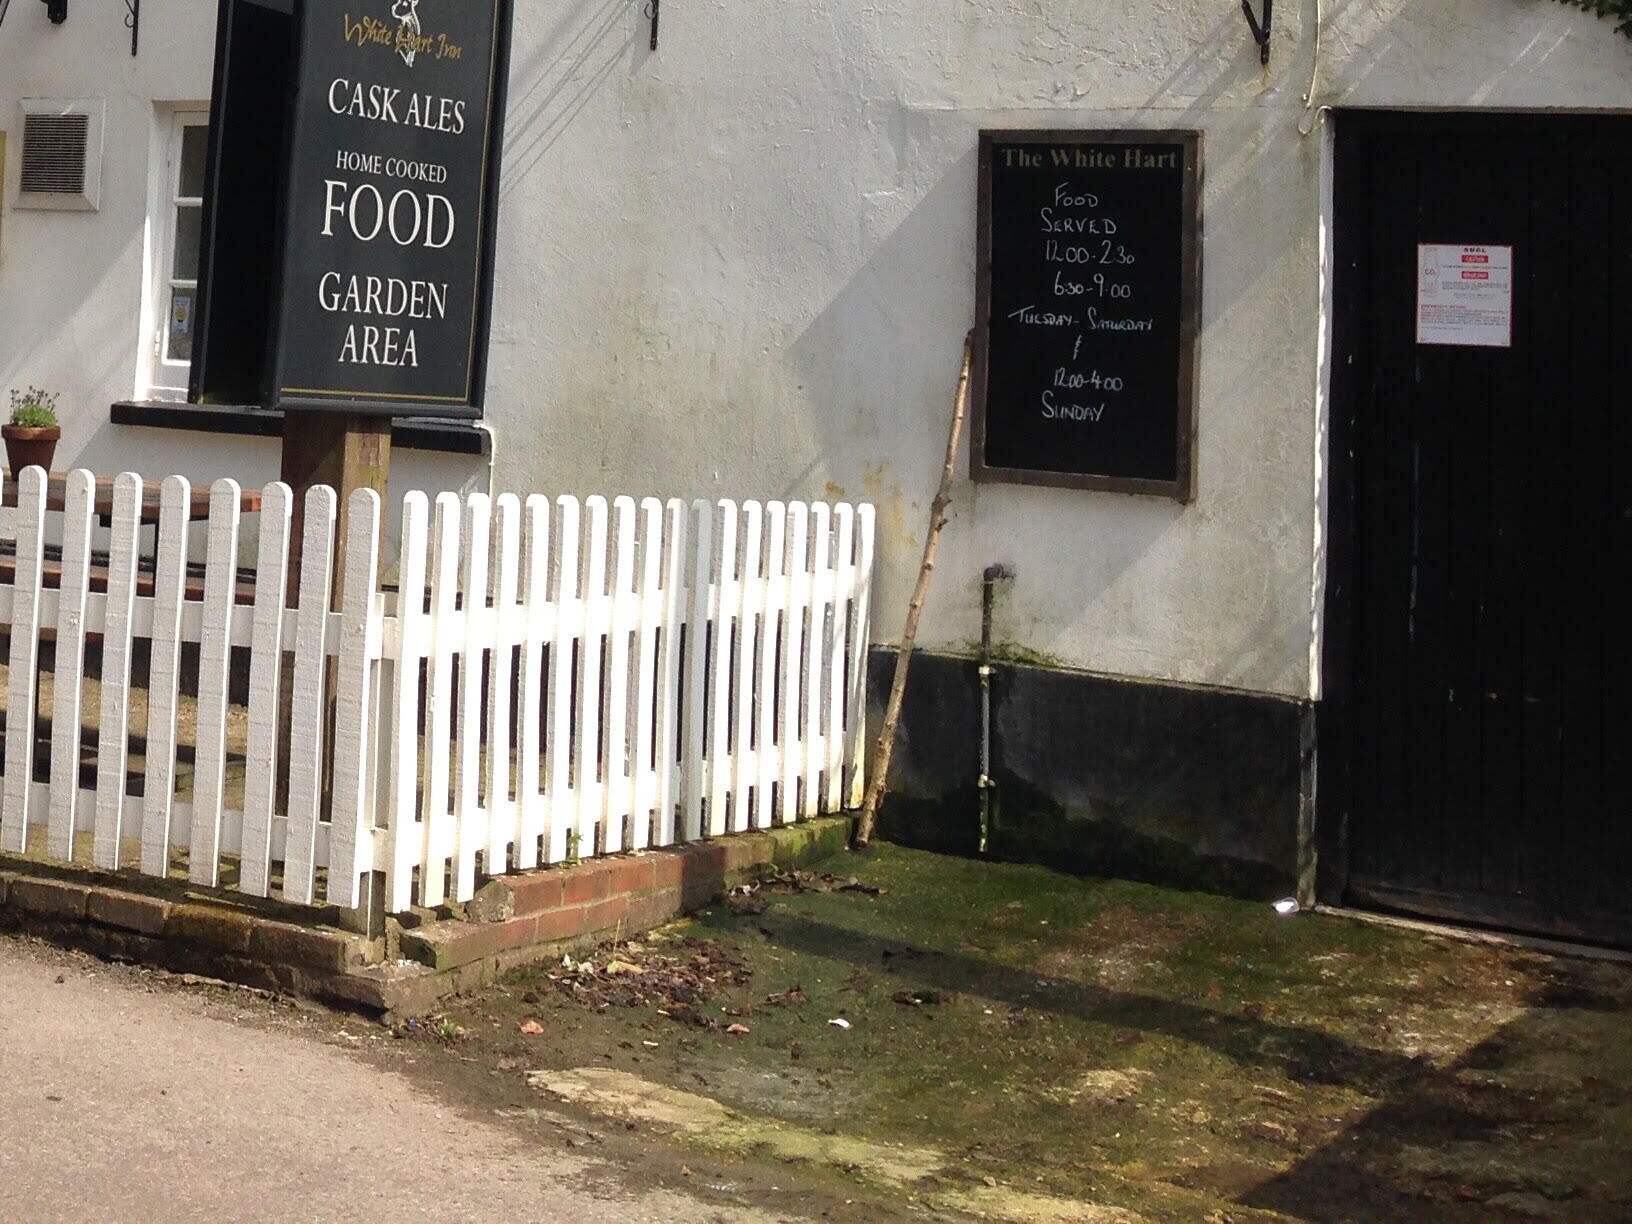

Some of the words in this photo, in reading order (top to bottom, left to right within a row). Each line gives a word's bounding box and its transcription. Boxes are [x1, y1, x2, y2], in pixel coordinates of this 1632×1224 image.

[344, 13, 392, 47] White
[394, 24, 434, 53] Hart
[435, 33, 464, 60] Inn
[328, 78, 401, 123] CASK
[404, 92, 466, 135] ALES
[336, 150, 382, 175] HOME
[385, 157, 448, 183] COOKED
[1002, 148, 1042, 168] The
[1051, 147, 1116, 168] White
[1124, 148, 1179, 169] Hart
[321, 179, 455, 248] FOOD
[318, 271, 449, 319] GARDEN
[337, 324, 419, 367] AREA
